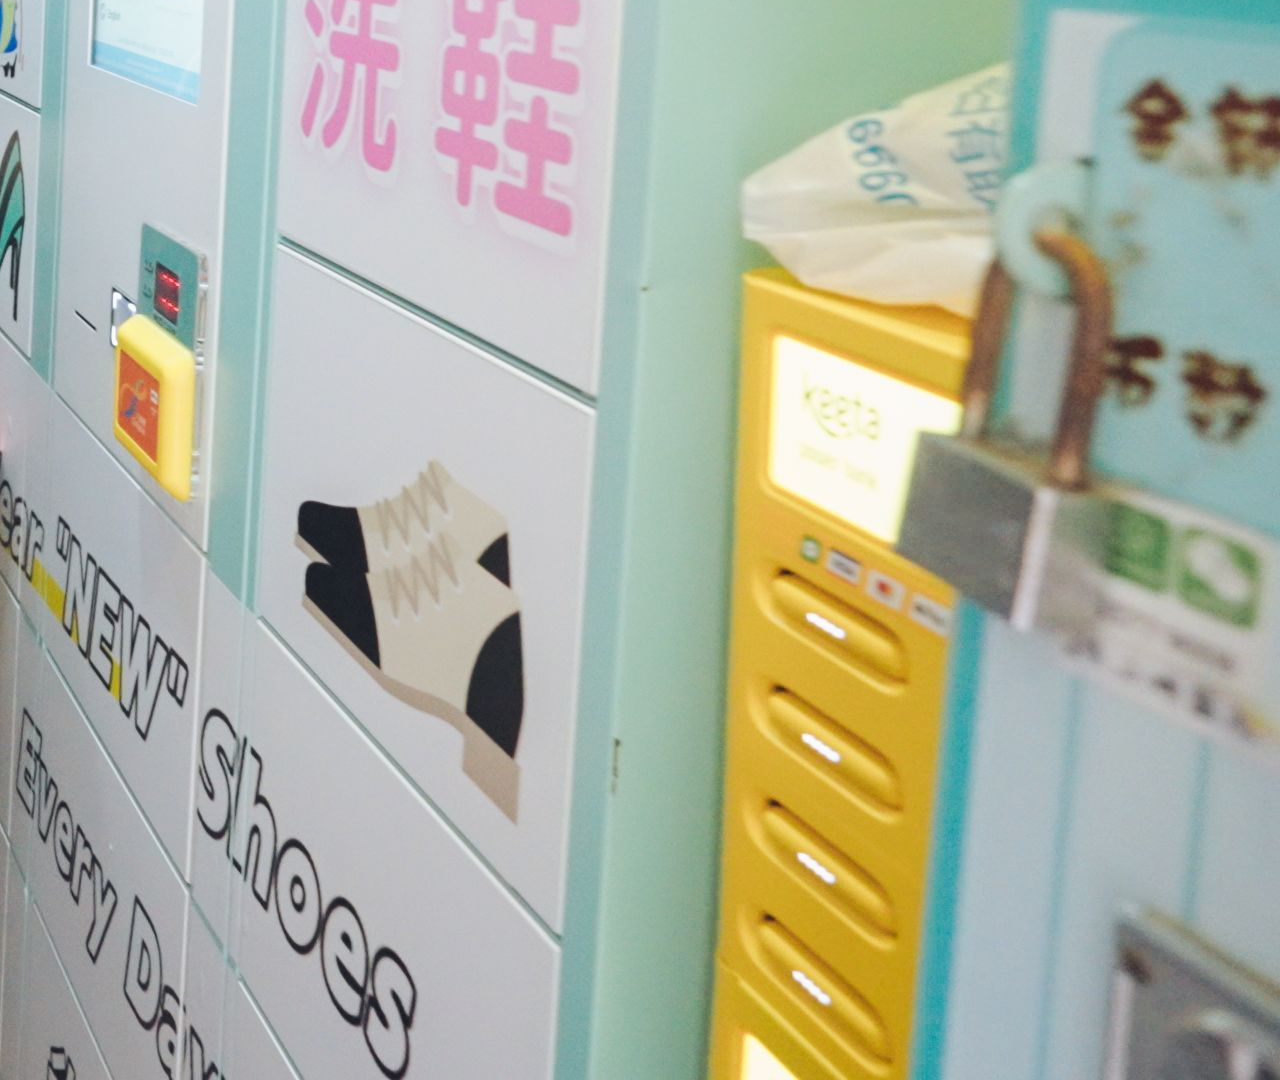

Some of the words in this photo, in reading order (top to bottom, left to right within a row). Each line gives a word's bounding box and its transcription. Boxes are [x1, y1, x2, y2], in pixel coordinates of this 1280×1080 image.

[15, 706, 119, 964] Every
[55, 516, 190, 742] "NEW"
[196, 707, 418, 1080] Shoes
